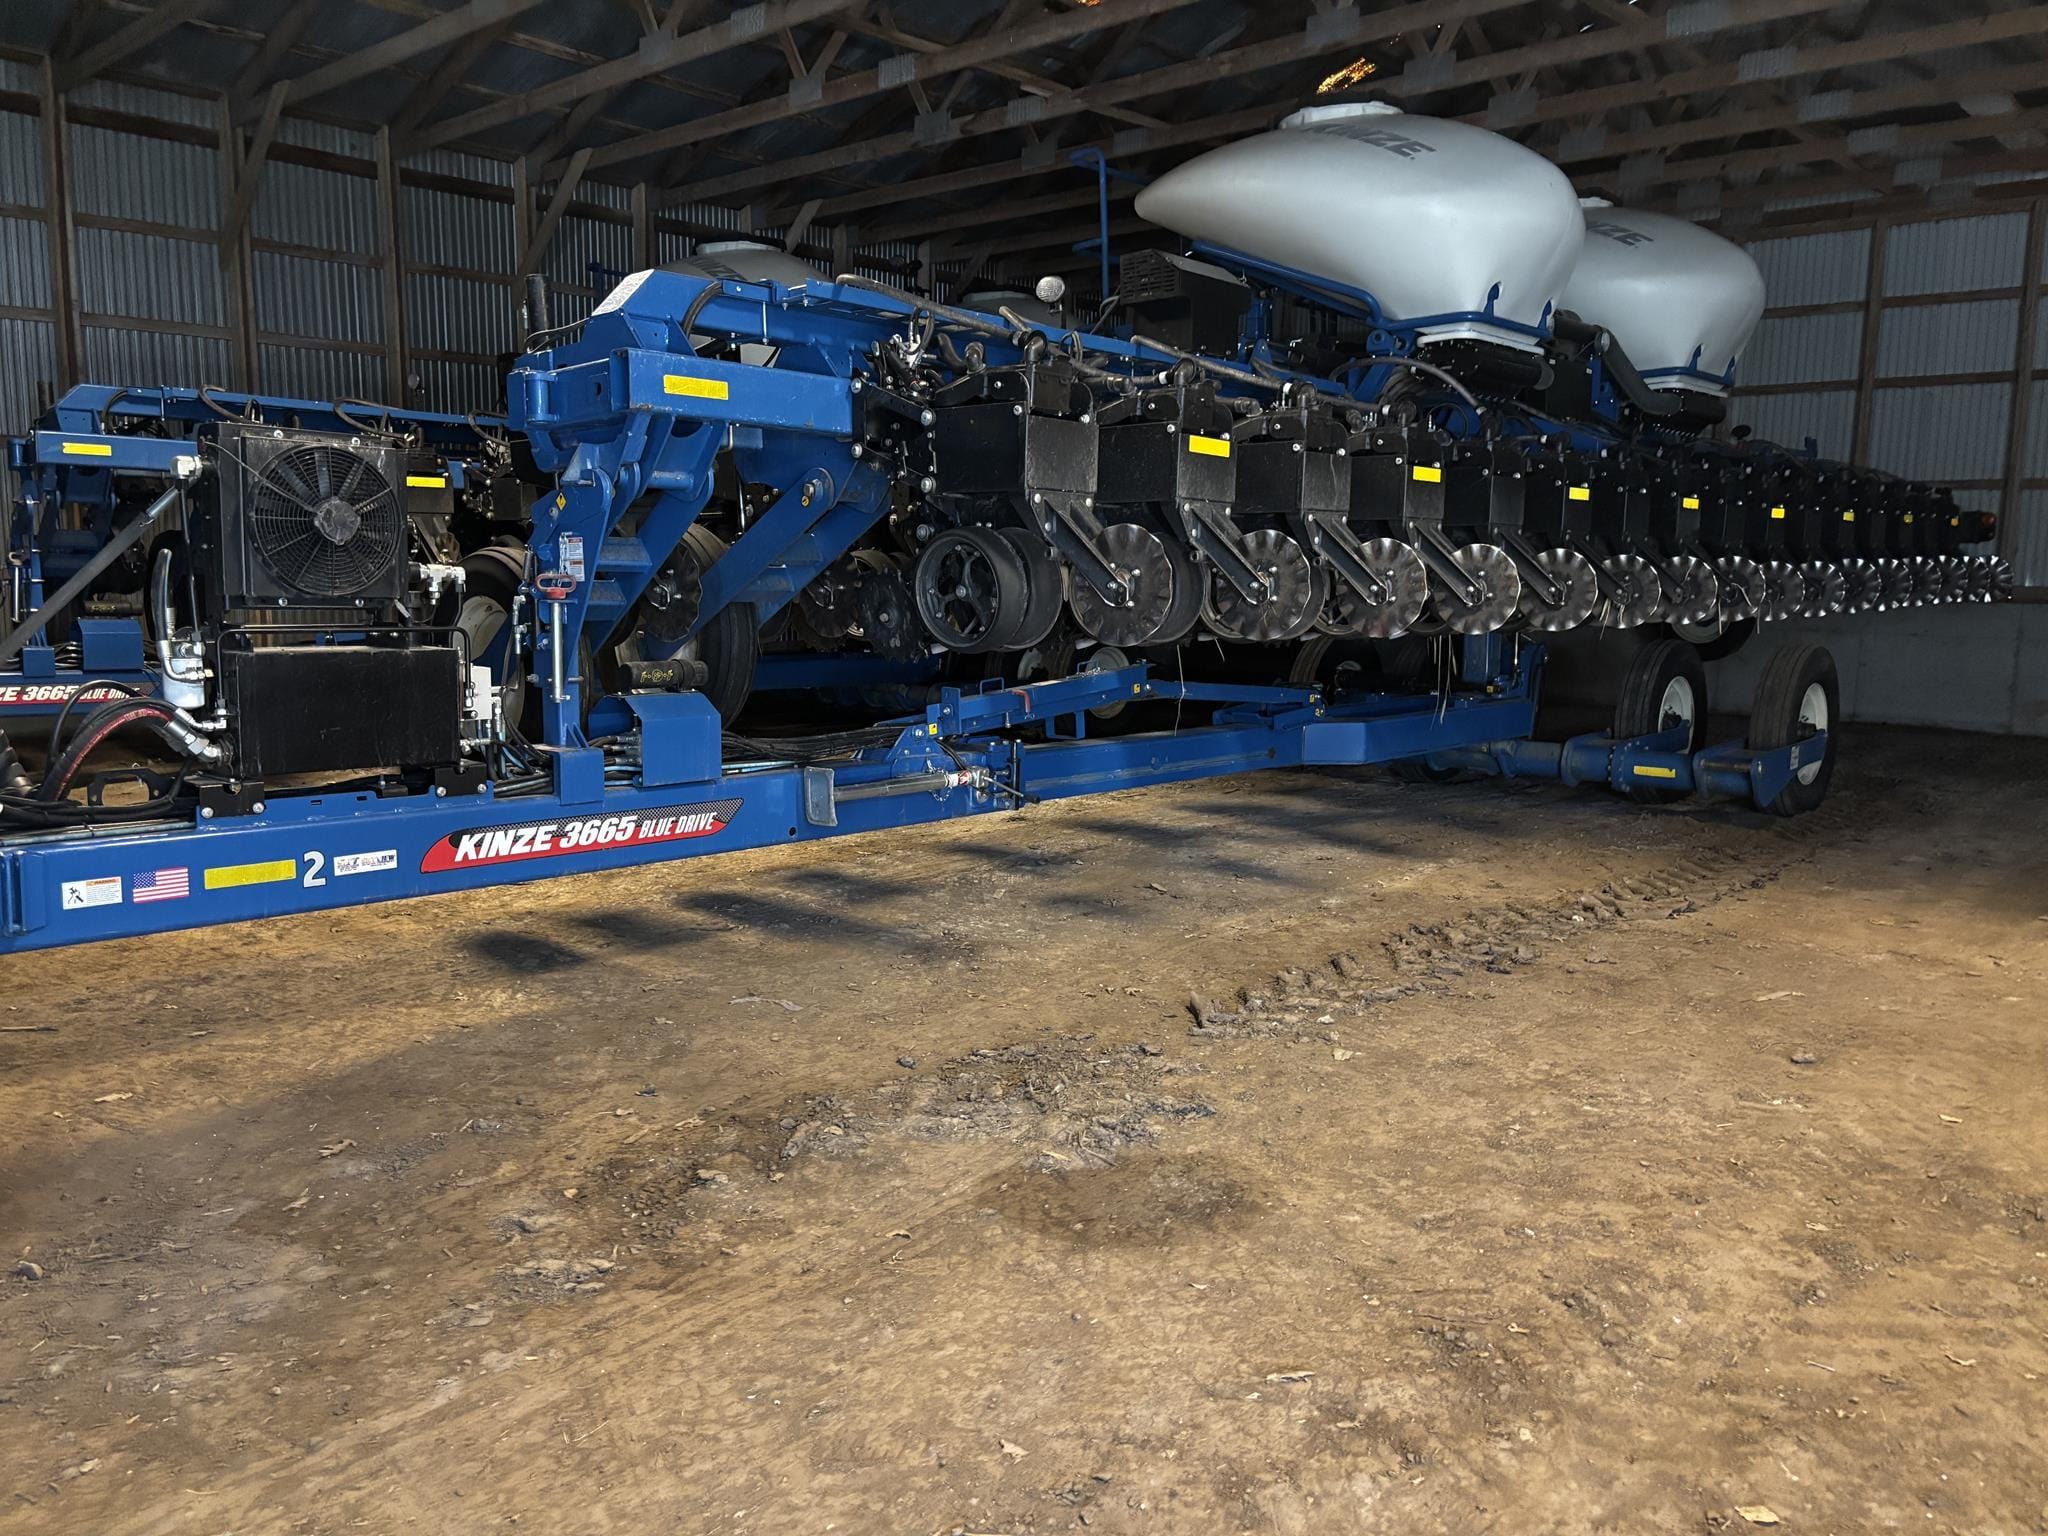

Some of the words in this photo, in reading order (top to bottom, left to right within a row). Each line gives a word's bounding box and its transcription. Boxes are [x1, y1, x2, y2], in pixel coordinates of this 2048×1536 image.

[454, 823, 558, 863] KINZE
[559, 814, 638, 849] 3665
[638, 817, 675, 839] BLUE
[674, 811, 718, 835] DRIVE
[303, 850, 326, 888] 2
